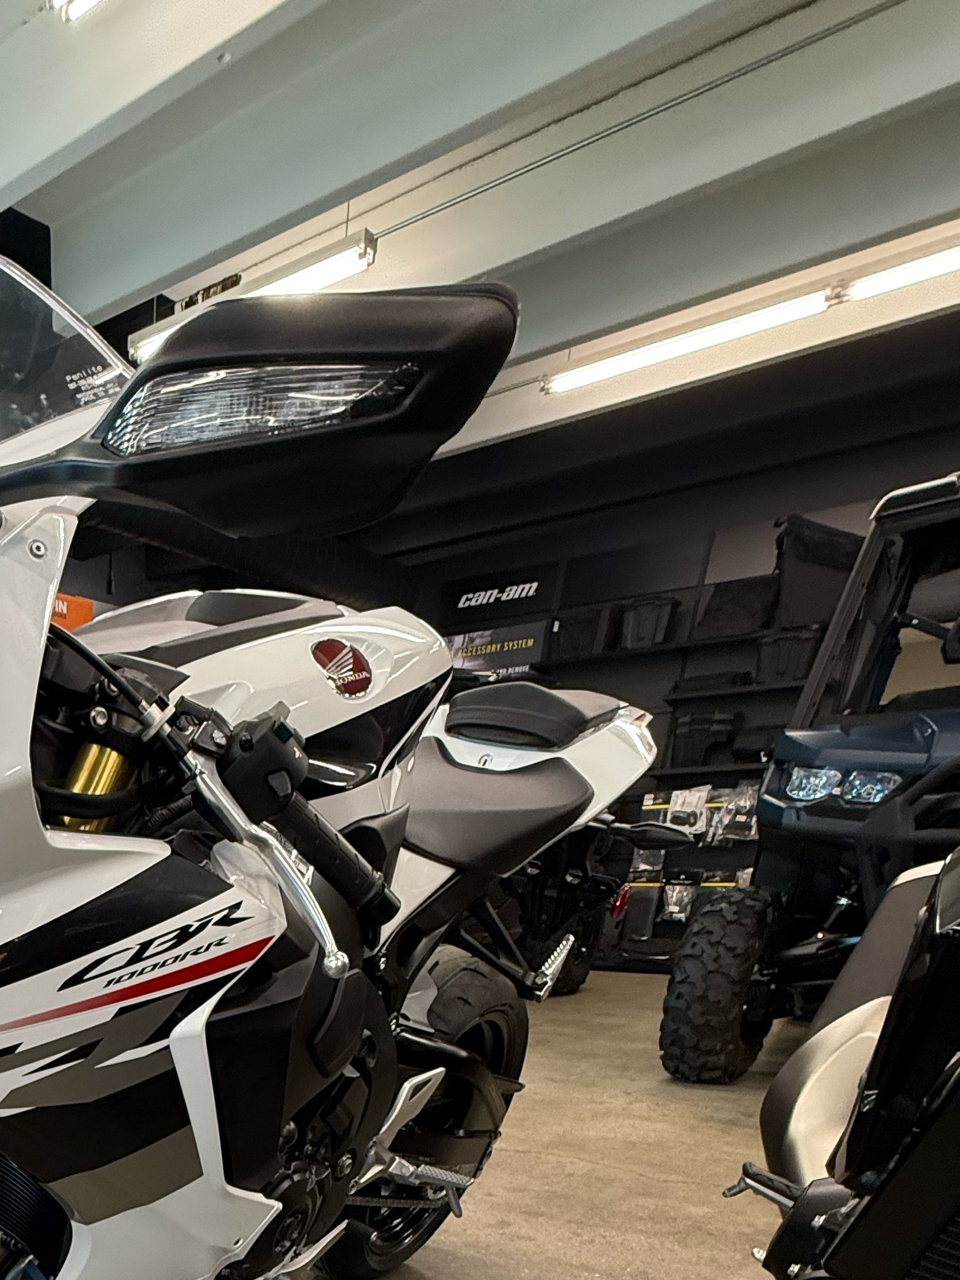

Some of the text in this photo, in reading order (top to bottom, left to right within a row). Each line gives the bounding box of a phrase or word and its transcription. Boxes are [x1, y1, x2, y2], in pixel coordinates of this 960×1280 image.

[457, 581, 539, 609] can-am
[503, 638, 535, 652] SYSTEM
[56, 899, 256, 992] CBR
[102, 935, 230, 989] 1000RR
